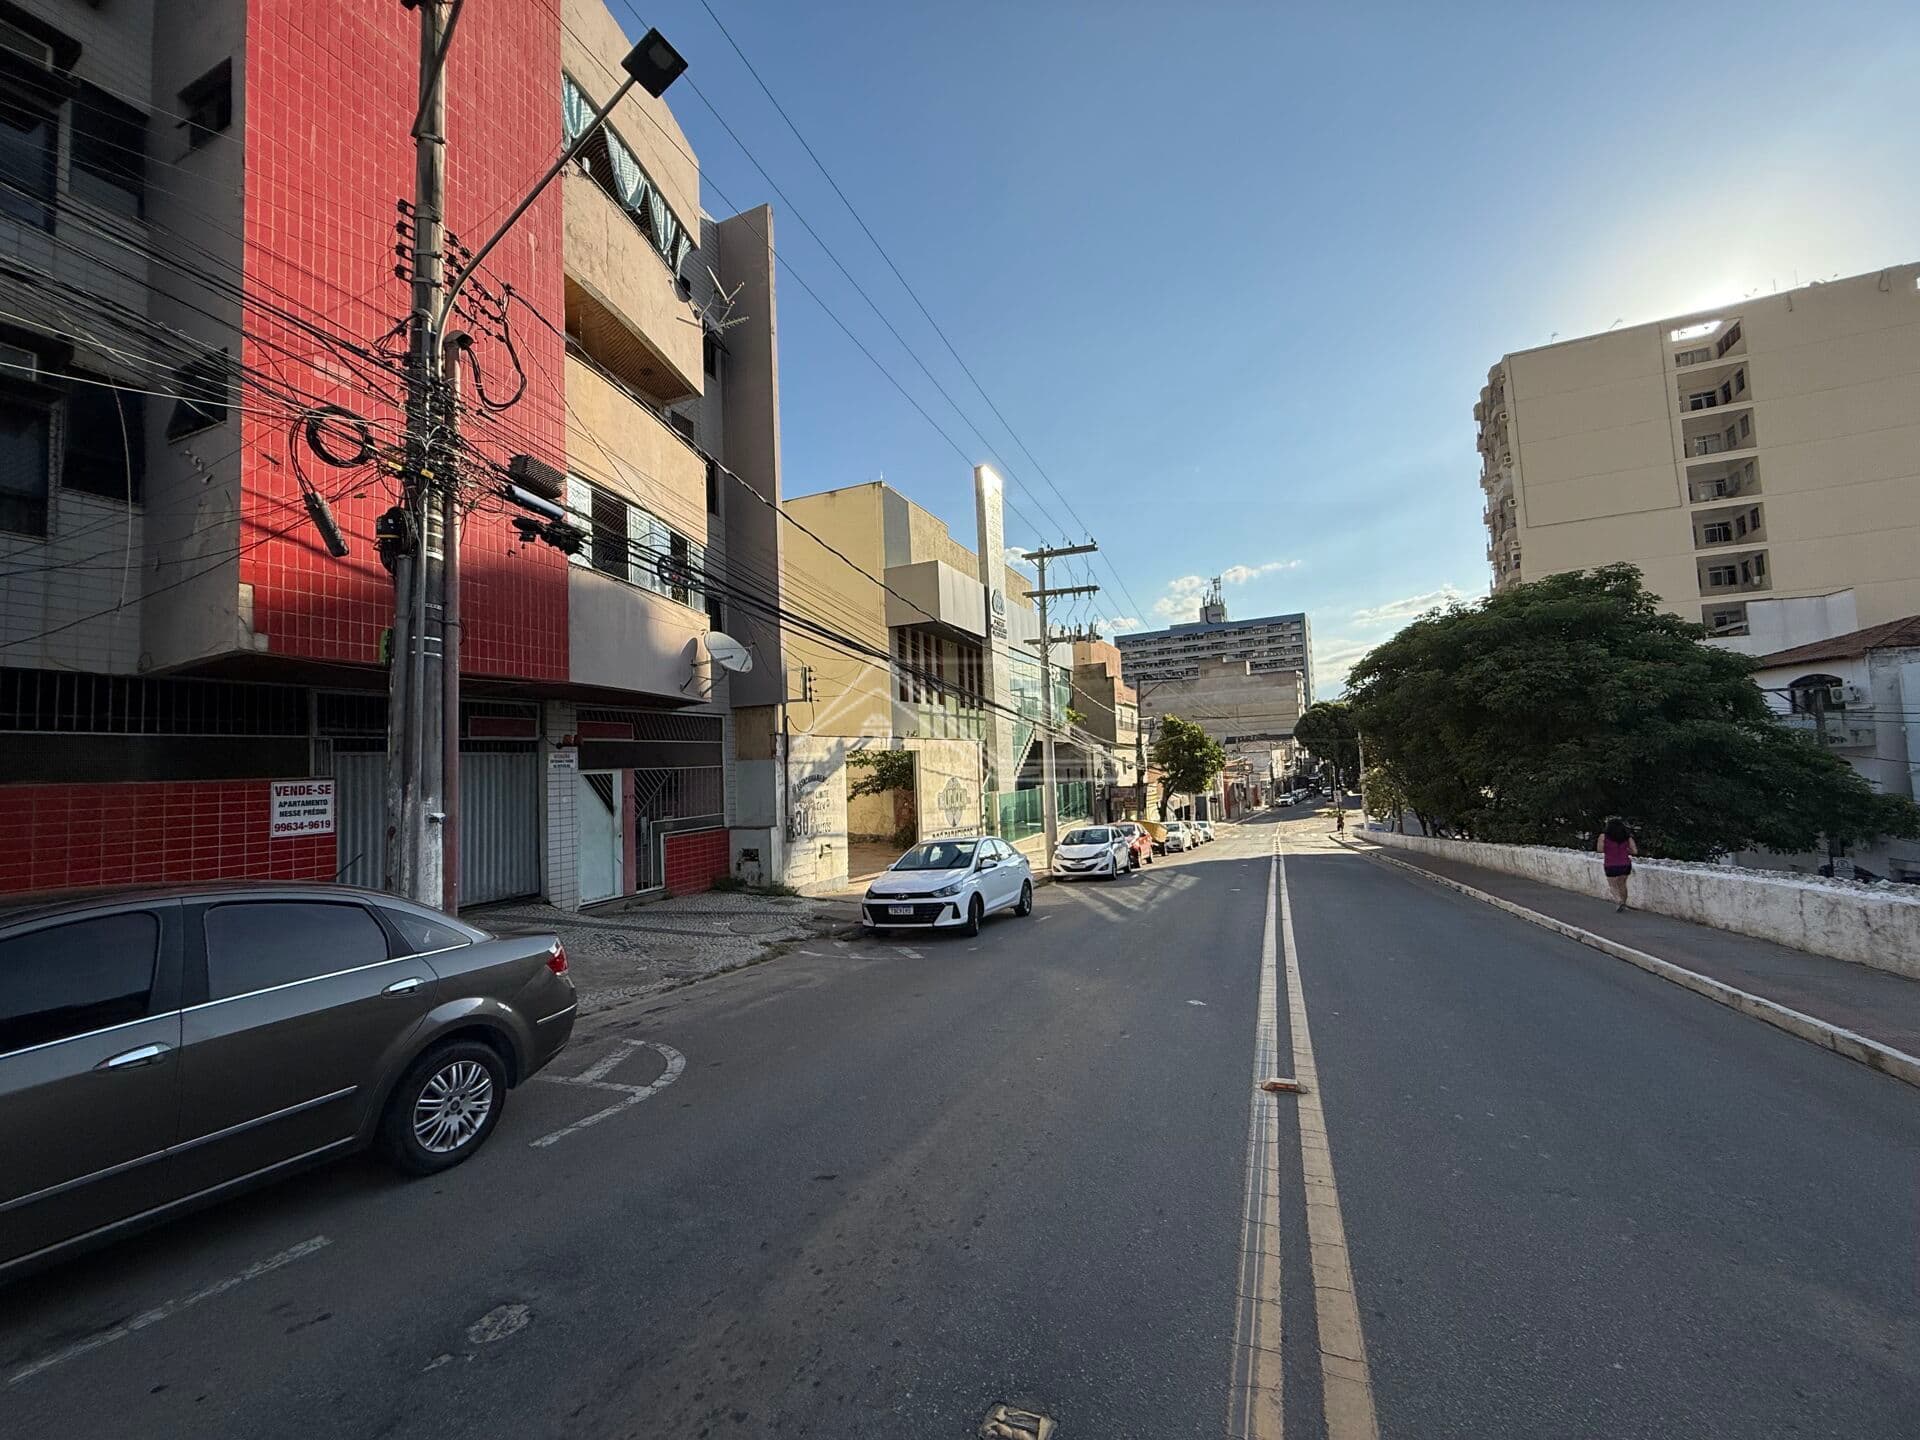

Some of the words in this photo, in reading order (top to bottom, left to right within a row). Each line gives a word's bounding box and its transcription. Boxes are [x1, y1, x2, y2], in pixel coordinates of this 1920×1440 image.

[275, 784, 332, 796] VENDE-SE
[278, 799, 328, 808] APARTAMENTO
[279, 809, 302, 817] NESSE
[303, 808, 327, 816] PRÉDIO
[274, 820, 331, 832] 99634-9619
[795, 810, 809, 836] 30
